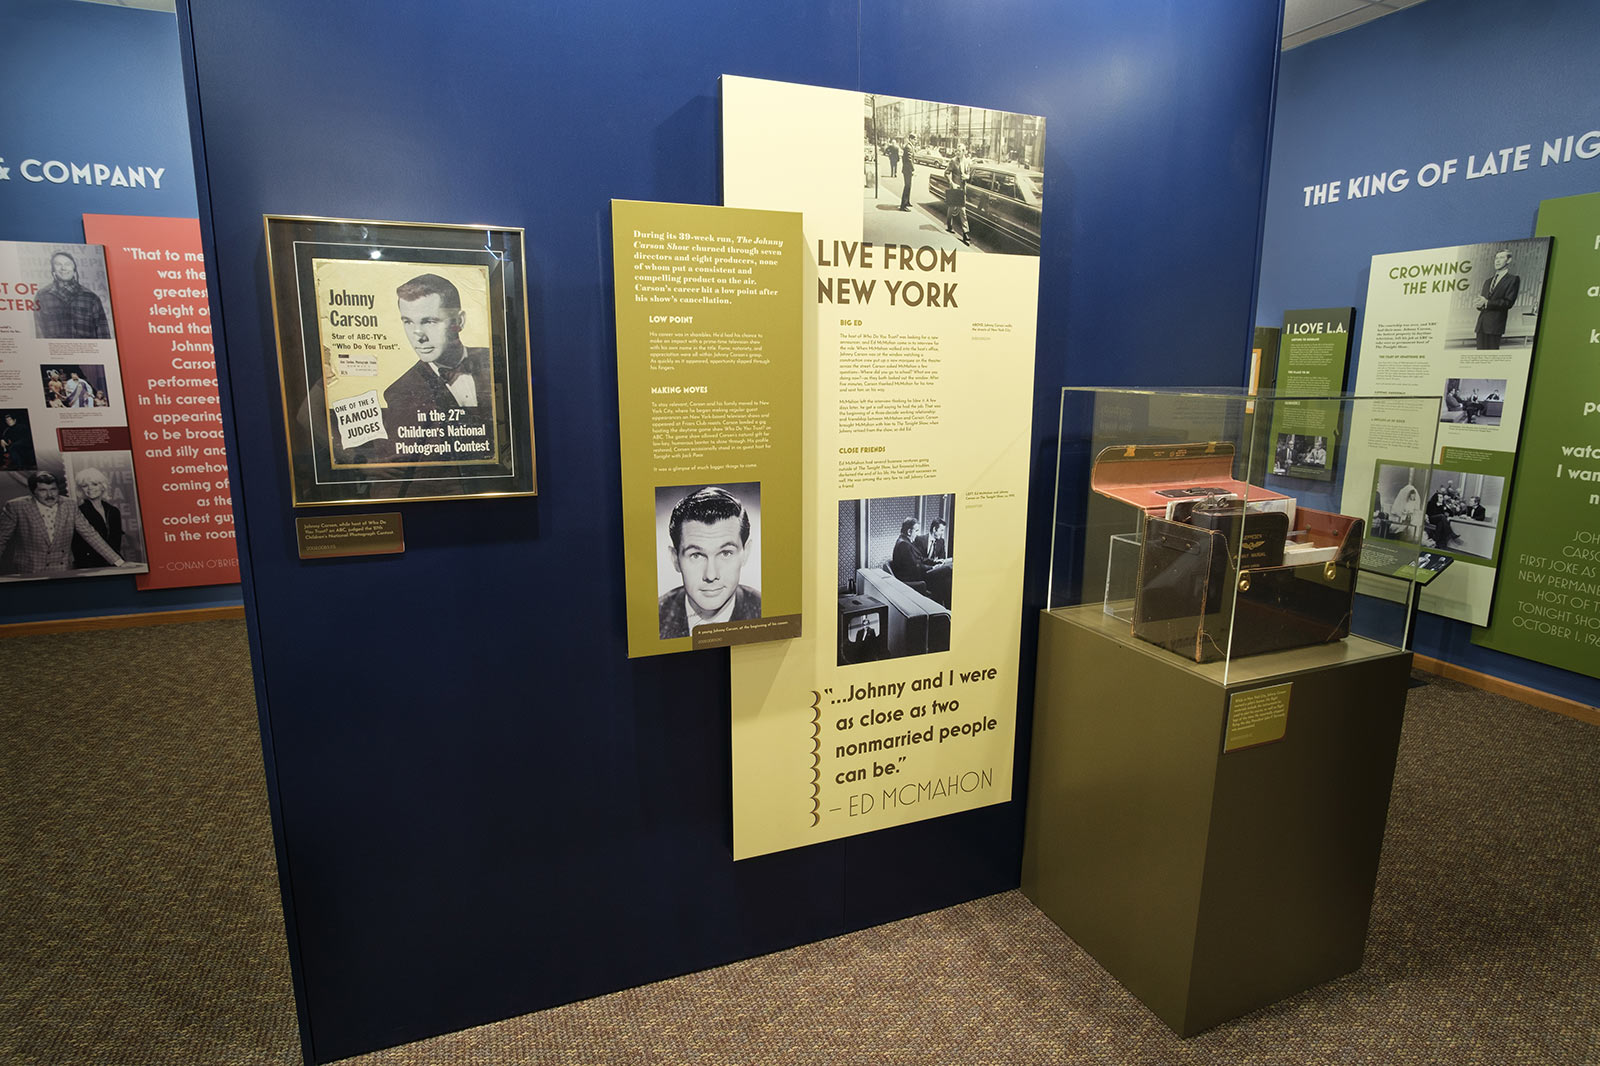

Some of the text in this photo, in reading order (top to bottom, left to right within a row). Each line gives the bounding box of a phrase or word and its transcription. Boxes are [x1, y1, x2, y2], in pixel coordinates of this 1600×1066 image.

[20, 159, 165, 189] COMPANY
[1304, 181, 1341, 206] THE
[1347, 169, 1409, 200] KING
[1417, 159, 1457, 187] OF
[1466, 144, 1531, 180] LATE
[634, 230, 664, 241] During
[679, 232, 714, 242] 39-week
[717, 236, 734, 244] run,
[754, 237, 783, 248] Johnny
[634, 241, 664, 250] Carson
[692, 244, 725, 253] churned
[728, 247, 759, 256] through
[165, 250, 180, 260] to
[185, 252, 204, 262] me
[634, 252, 672, 260] directors
[692, 255, 712, 263] eight
[714, 257, 757, 265] producers,
[818, 240, 957, 272] LIVE FROM
[157, 268, 206, 280] was the
[672, 264, 686, 273] put
[1389, 261, 1472, 279] CROWNING
[635, 274, 681, 283] compelling
[683, 276, 714, 284] product
[1403, 278, 1470, 294] THE KING
[15, 283, 38, 295] OF
[737, 288, 757, 296] point
[818, 277, 958, 308] NEW YORK
[329, 289, 375, 309] Johnny
[149, 304, 194, 318] sleight
[330, 310, 378, 327] Carson
[148, 322, 183, 334] hand
[1287, 322, 1346, 334] I LOVE L.A.
[171, 340, 214, 354] Johnny
[138, 395, 150, 405] in
[155, 394, 171, 405] his
[335, 404, 347, 413] ONE
[358, 400, 369, 408] THE
[340, 407, 379, 426] FAMOUS
[418, 411, 426, 422] in
[430, 411, 446, 421] the
[144, 429, 181, 440] to be
[347, 422, 380, 439] JUDGES
[398, 424, 486, 438] Children's National
[146, 446, 199, 458] and silly
[396, 440, 490, 456] Photograph Contest
[1557, 464, 1562, 477] I
[162, 480, 211, 492] coming
[197, 496, 232, 507] as the
[162, 513, 210, 525] coolest
[165, 532, 176, 542] in
[180, 530, 201, 541] the
[167, 560, 204, 571] CONAN
[1520, 554, 1596, 578] FIRST JOKE AS
[1519, 570, 1545, 584] NEW
[1537, 590, 1590, 610] HOST OF
[1518, 601, 1572, 622] TONIGHT
[1513, 616, 1571, 639] OCTOBER
[911, 672, 943, 692] and
[950, 670, 953, 685] I
[960, 668, 997, 683] were
[836, 700, 960, 731] as close as two
[835, 716, 997, 758] nonmarried people
[835, 768, 866, 784] can
[850, 768, 992, 817] ED MCMAHON
